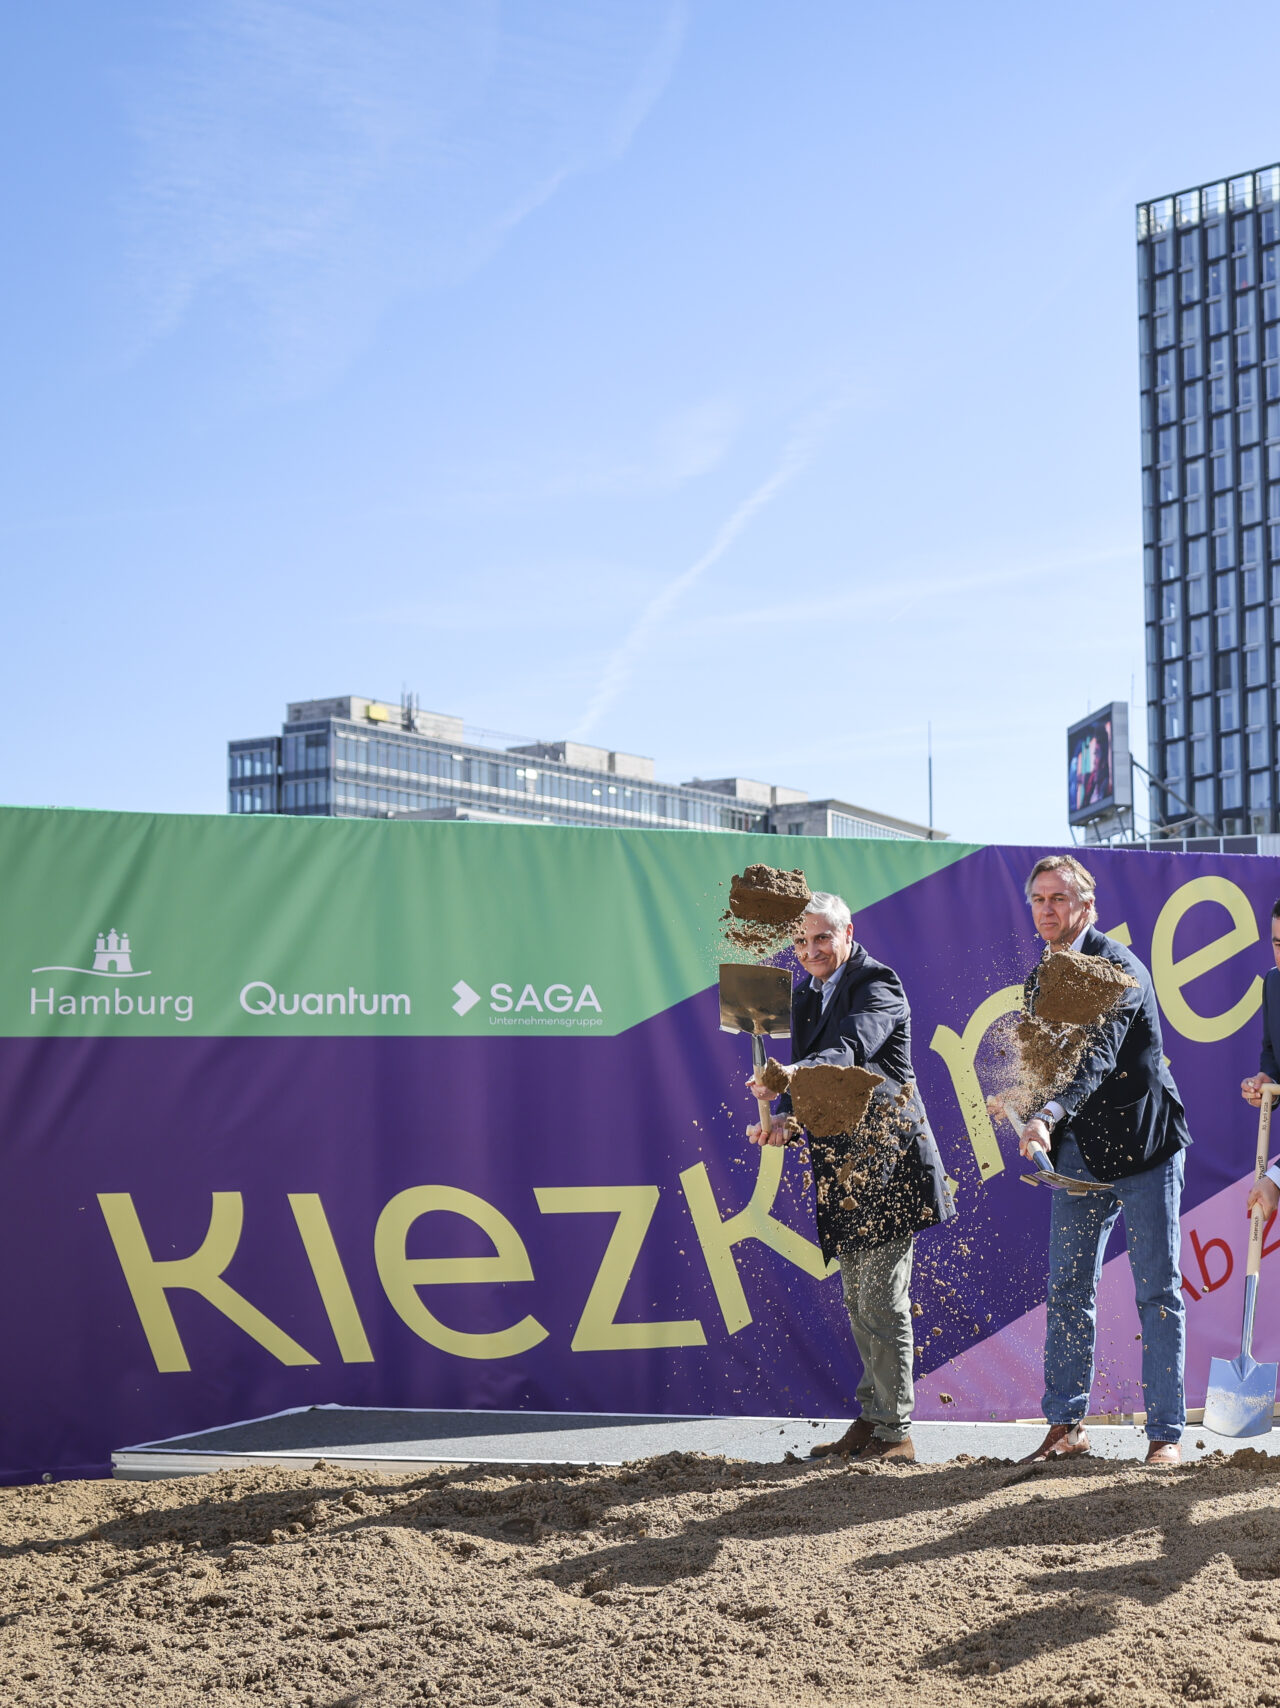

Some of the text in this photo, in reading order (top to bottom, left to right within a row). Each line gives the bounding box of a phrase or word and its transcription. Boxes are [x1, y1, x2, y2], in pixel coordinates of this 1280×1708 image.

[30, 987, 193, 1022] Hamburg
[239, 981, 411, 1016] Quantum
[489, 983, 603, 1013] SAGA
[489, 1016, 603, 1028] Unternehmensgruppe
